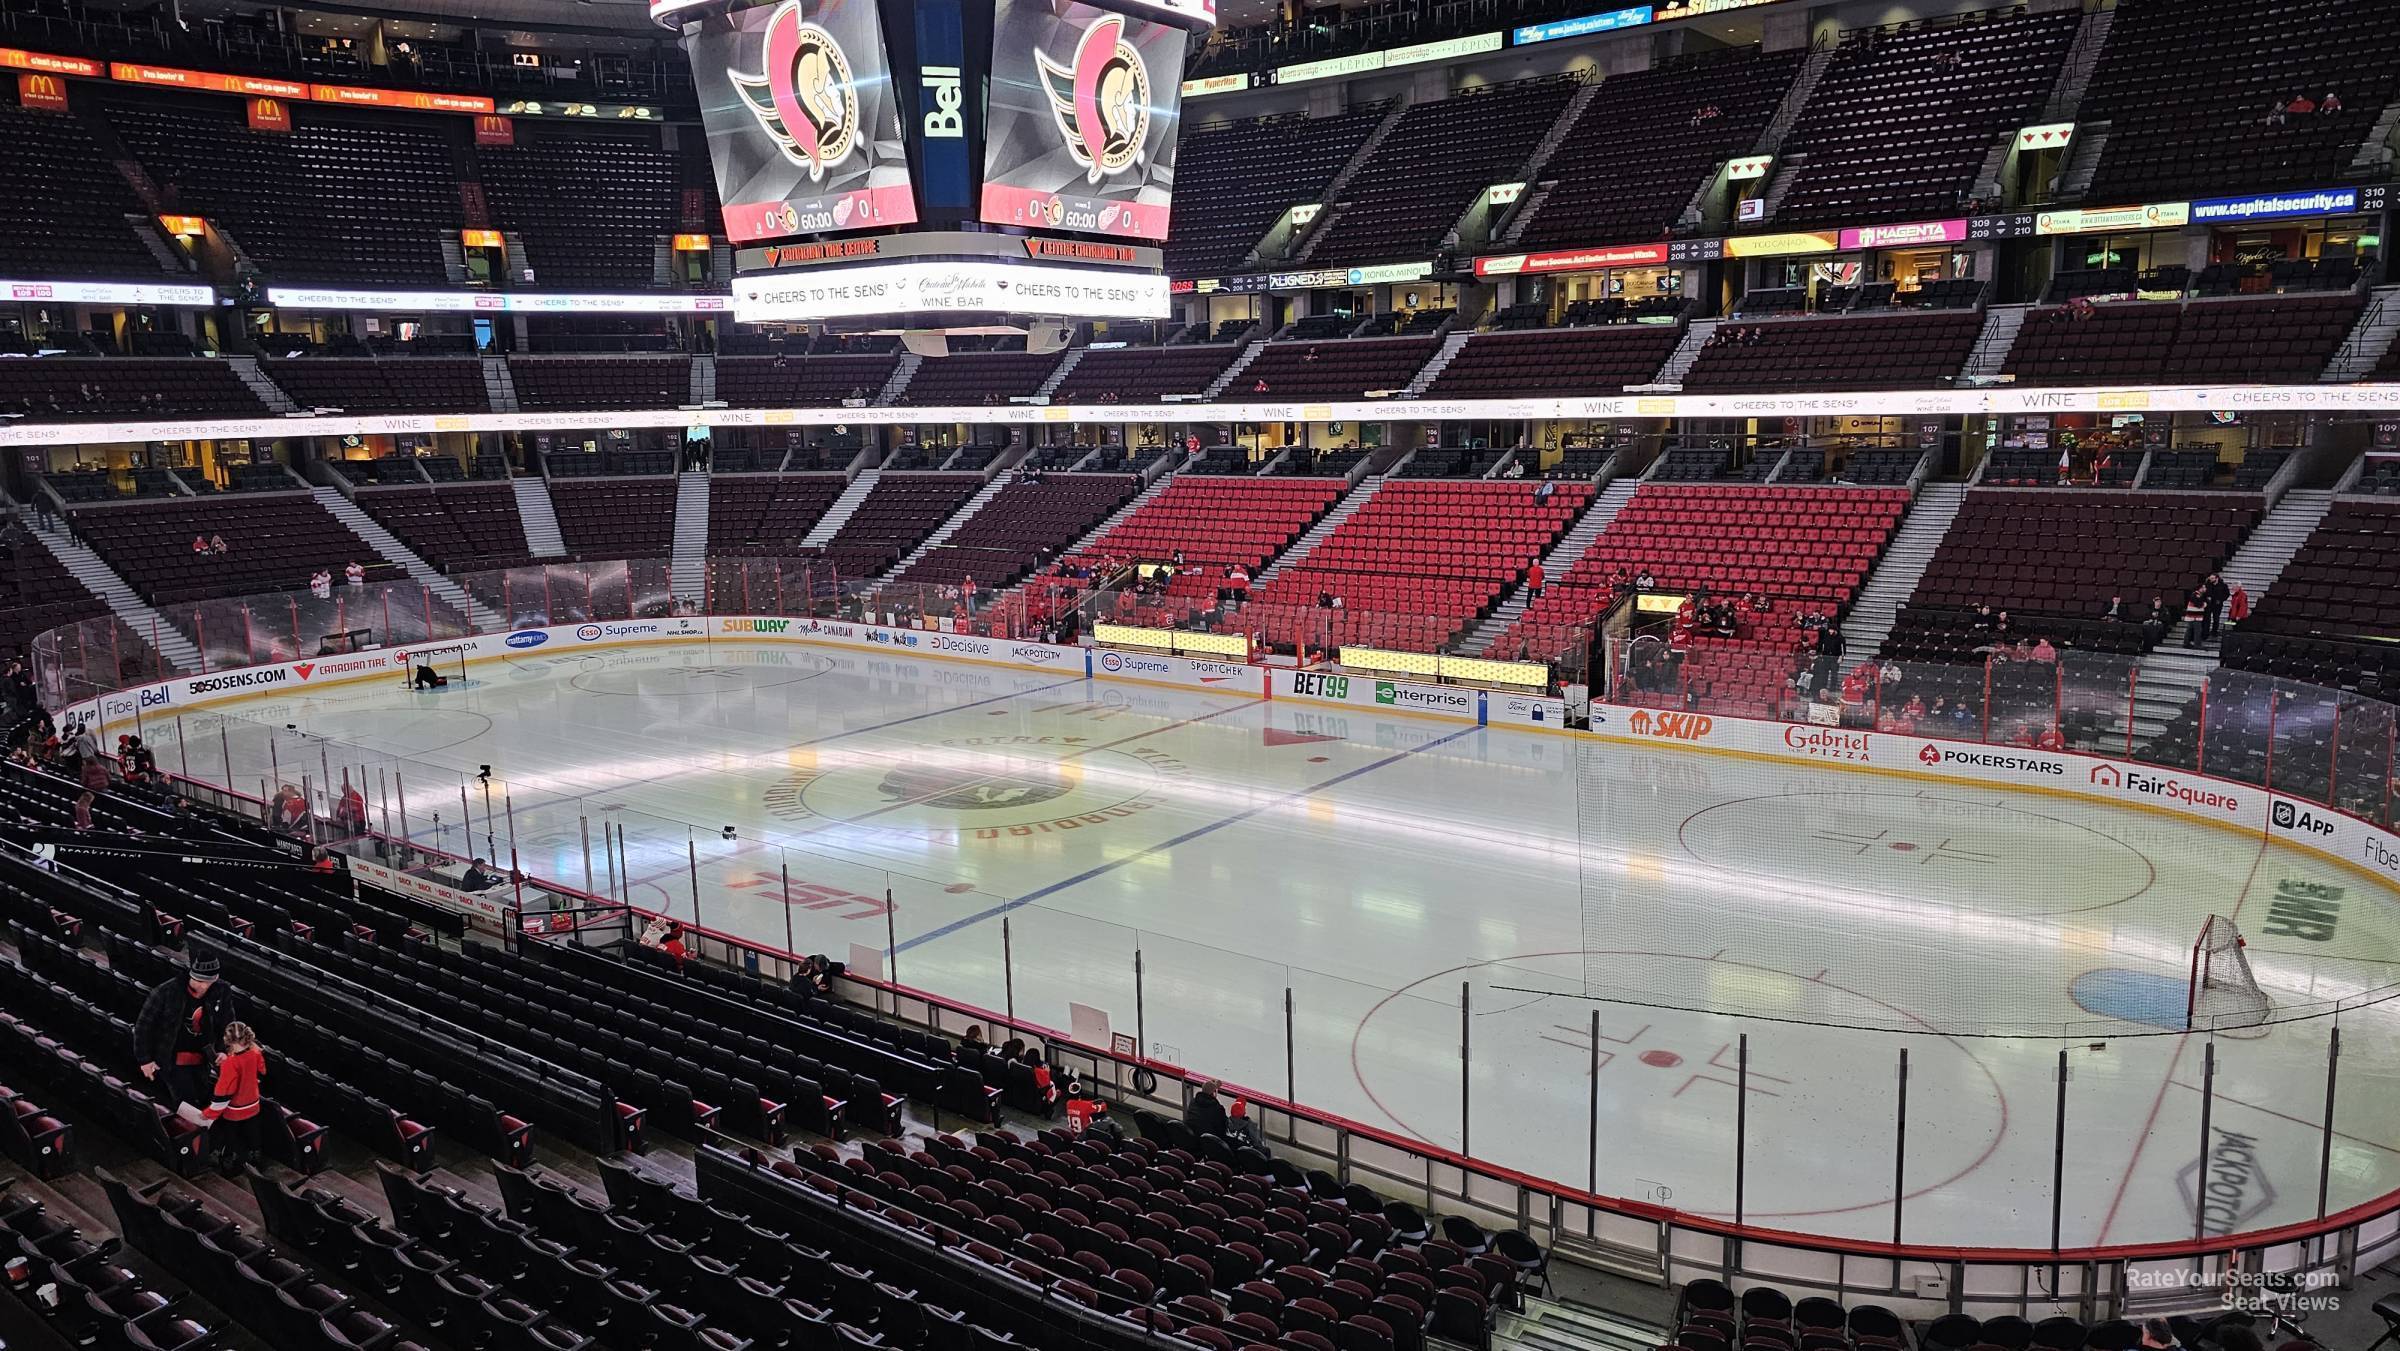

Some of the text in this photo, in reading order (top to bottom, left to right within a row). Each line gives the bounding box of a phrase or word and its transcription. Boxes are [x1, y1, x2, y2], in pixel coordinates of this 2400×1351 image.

[143, 70, 156, 78] I'm
[156, 71, 177, 80] lovin'
[922, 66, 963, 137] Bell
[2365, 188, 2385, 197] 310
[859, 199, 869, 218] 0
[1029, 199, 1039, 218] 0
[2195, 194, 2354, 218] www.capitalsecurity.ca
[2364, 200, 2384, 208] 210
[765, 211, 775, 229] 0
[800, 211, 832, 230] 60:00
[1066, 211, 1095, 229] 60:00
[1123, 210, 1131, 228] 0
[1972, 219, 1990, 228] 309
[2015, 216, 2032, 225] 310
[1876, 224, 1946, 240] MAGENTA
[1971, 230, 1989, 239] 209
[2015, 226, 2031, 235] 210
[781, 239, 877, 262] CANADIAN TIRE CENTRE
[1043, 241, 1136, 261] CENTRE CANADIAN TIRE
[1704, 250, 1719, 258] 209
[1529, 258, 1548, 267] Know
[1574, 255, 1585, 263] Act
[1364, 266, 1430, 279] KONICA MINOLTA
[764, 289, 807, 304] CHEERS
[809, 288, 825, 301] TO
[828, 286, 850, 299] THE
[1015, 283, 1061, 298] CHEERS
[1065, 285, 1079, 299] TO
[1083, 287, 1103, 301] THE
[298, 295, 333, 303] CHEERS
[351, 296, 367, 304] THE
[921, 296, 984, 308] WINE BAR
[2022, 393, 2075, 407] WINE
[2232, 392, 2290, 402] CHEERS
[2297, 392, 2315, 401] TO
[2324, 391, 2350, 401] THE
[1375, 406, 1407, 414] CHEERS
[1423, 405, 1439, 413] THE
[1584, 402, 1624, 413] WINE
[1733, 401, 1776, 409] CHEERS
[1798, 400, 1819, 408] THE
[719, 413, 752, 423] WINE
[836, 412, 866, 420] CHEERS
[1008, 410, 1035, 420] WINE
[1263, 407, 1293, 418] WINE
[152, 427, 192, 435] CHEERS
[210, 425, 229, 433] THE
[384, 419, 421, 430] WINE
[1922, 425, 1938, 433] 107
[2377, 424, 2397, 432] 109
[27, 454, 41, 462] 101
[605, 624, 658, 638] Supreme
[722, 619, 790, 633] SUBWAY
[824, 625, 853, 639] CANADIAN
[432, 641, 478, 657] CANADA
[942, 637, 989, 655] Decisive
[1012, 647, 1061, 661] JACKPOTCITY
[319, 656, 387, 675] CANADIAN TIRE
[1104, 658, 1169, 673] Esso Supreme
[190, 669, 286, 695] 5050SENS.COM
[1294, 672, 1349, 699] BET99
[140, 685, 170, 707] Bell
[1378, 685, 1468, 706] enterprise
[106, 699, 133, 716] Fibe
[1508, 701, 1528, 712] Ford
[78, 709, 96, 723] App
[1653, 711, 1713, 740] SKIP
[1784, 725, 1872, 751] Gabriel
[1810, 747, 1870, 762] PIZZA
[1944, 750, 2064, 775] POKERSTARS
[2126, 772, 2239, 812] FairSquare
[2297, 811, 2335, 838] App
[2365, 836, 2399, 872] Fibe
[1067, 1116, 1082, 1134] 19
